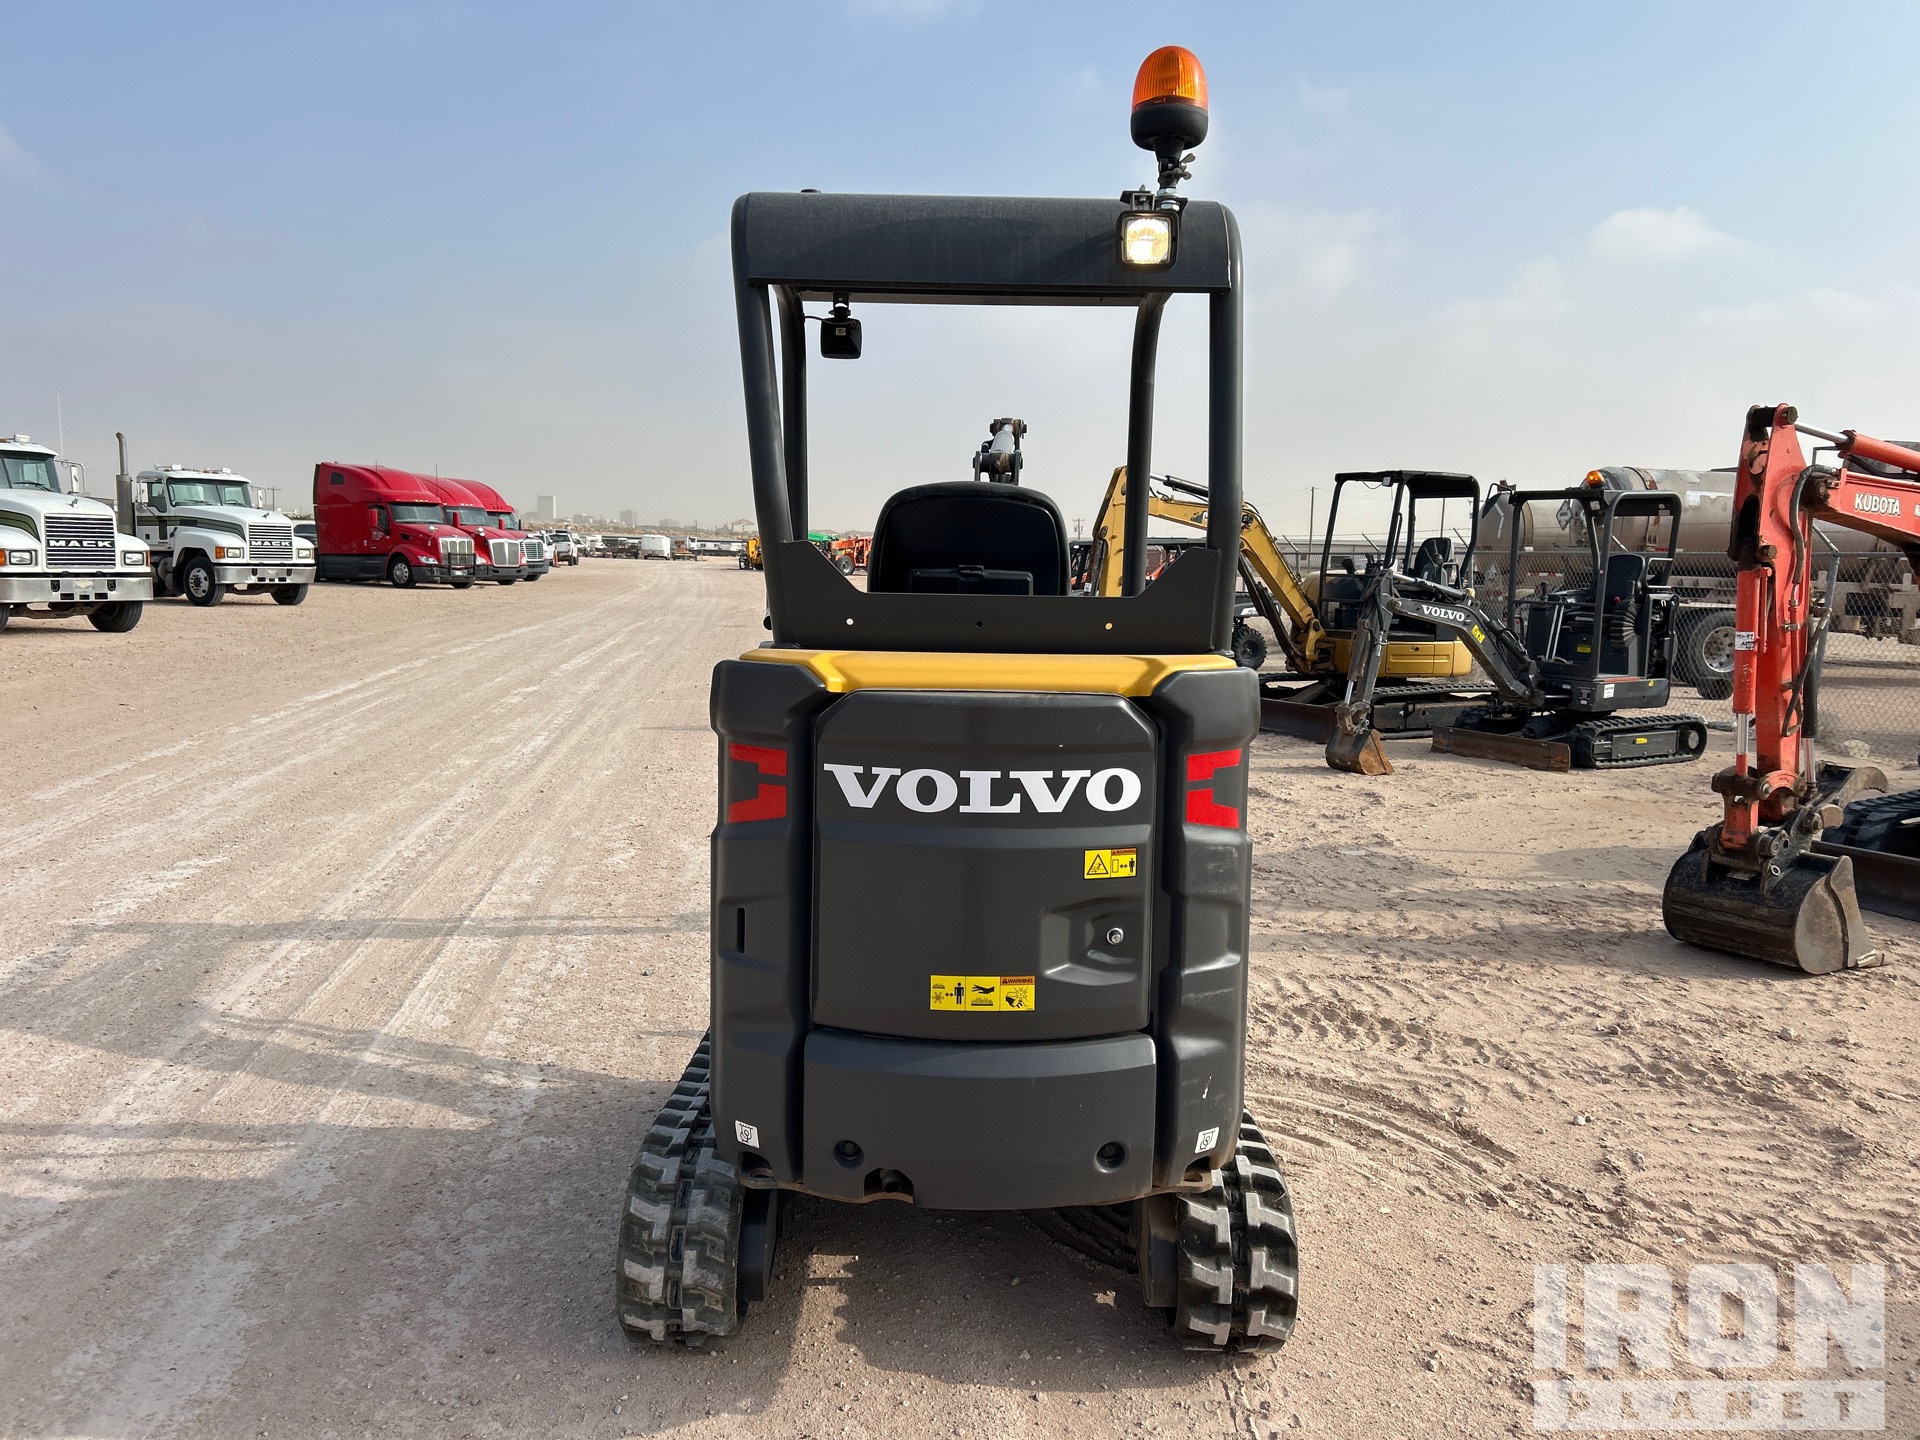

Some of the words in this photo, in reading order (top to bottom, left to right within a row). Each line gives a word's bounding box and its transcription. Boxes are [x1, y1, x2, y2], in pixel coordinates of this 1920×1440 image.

[1855, 493, 1900, 515] KUBOTA
[1421, 604, 1465, 621] VOLVO
[823, 763, 1142, 813] VOLVO
